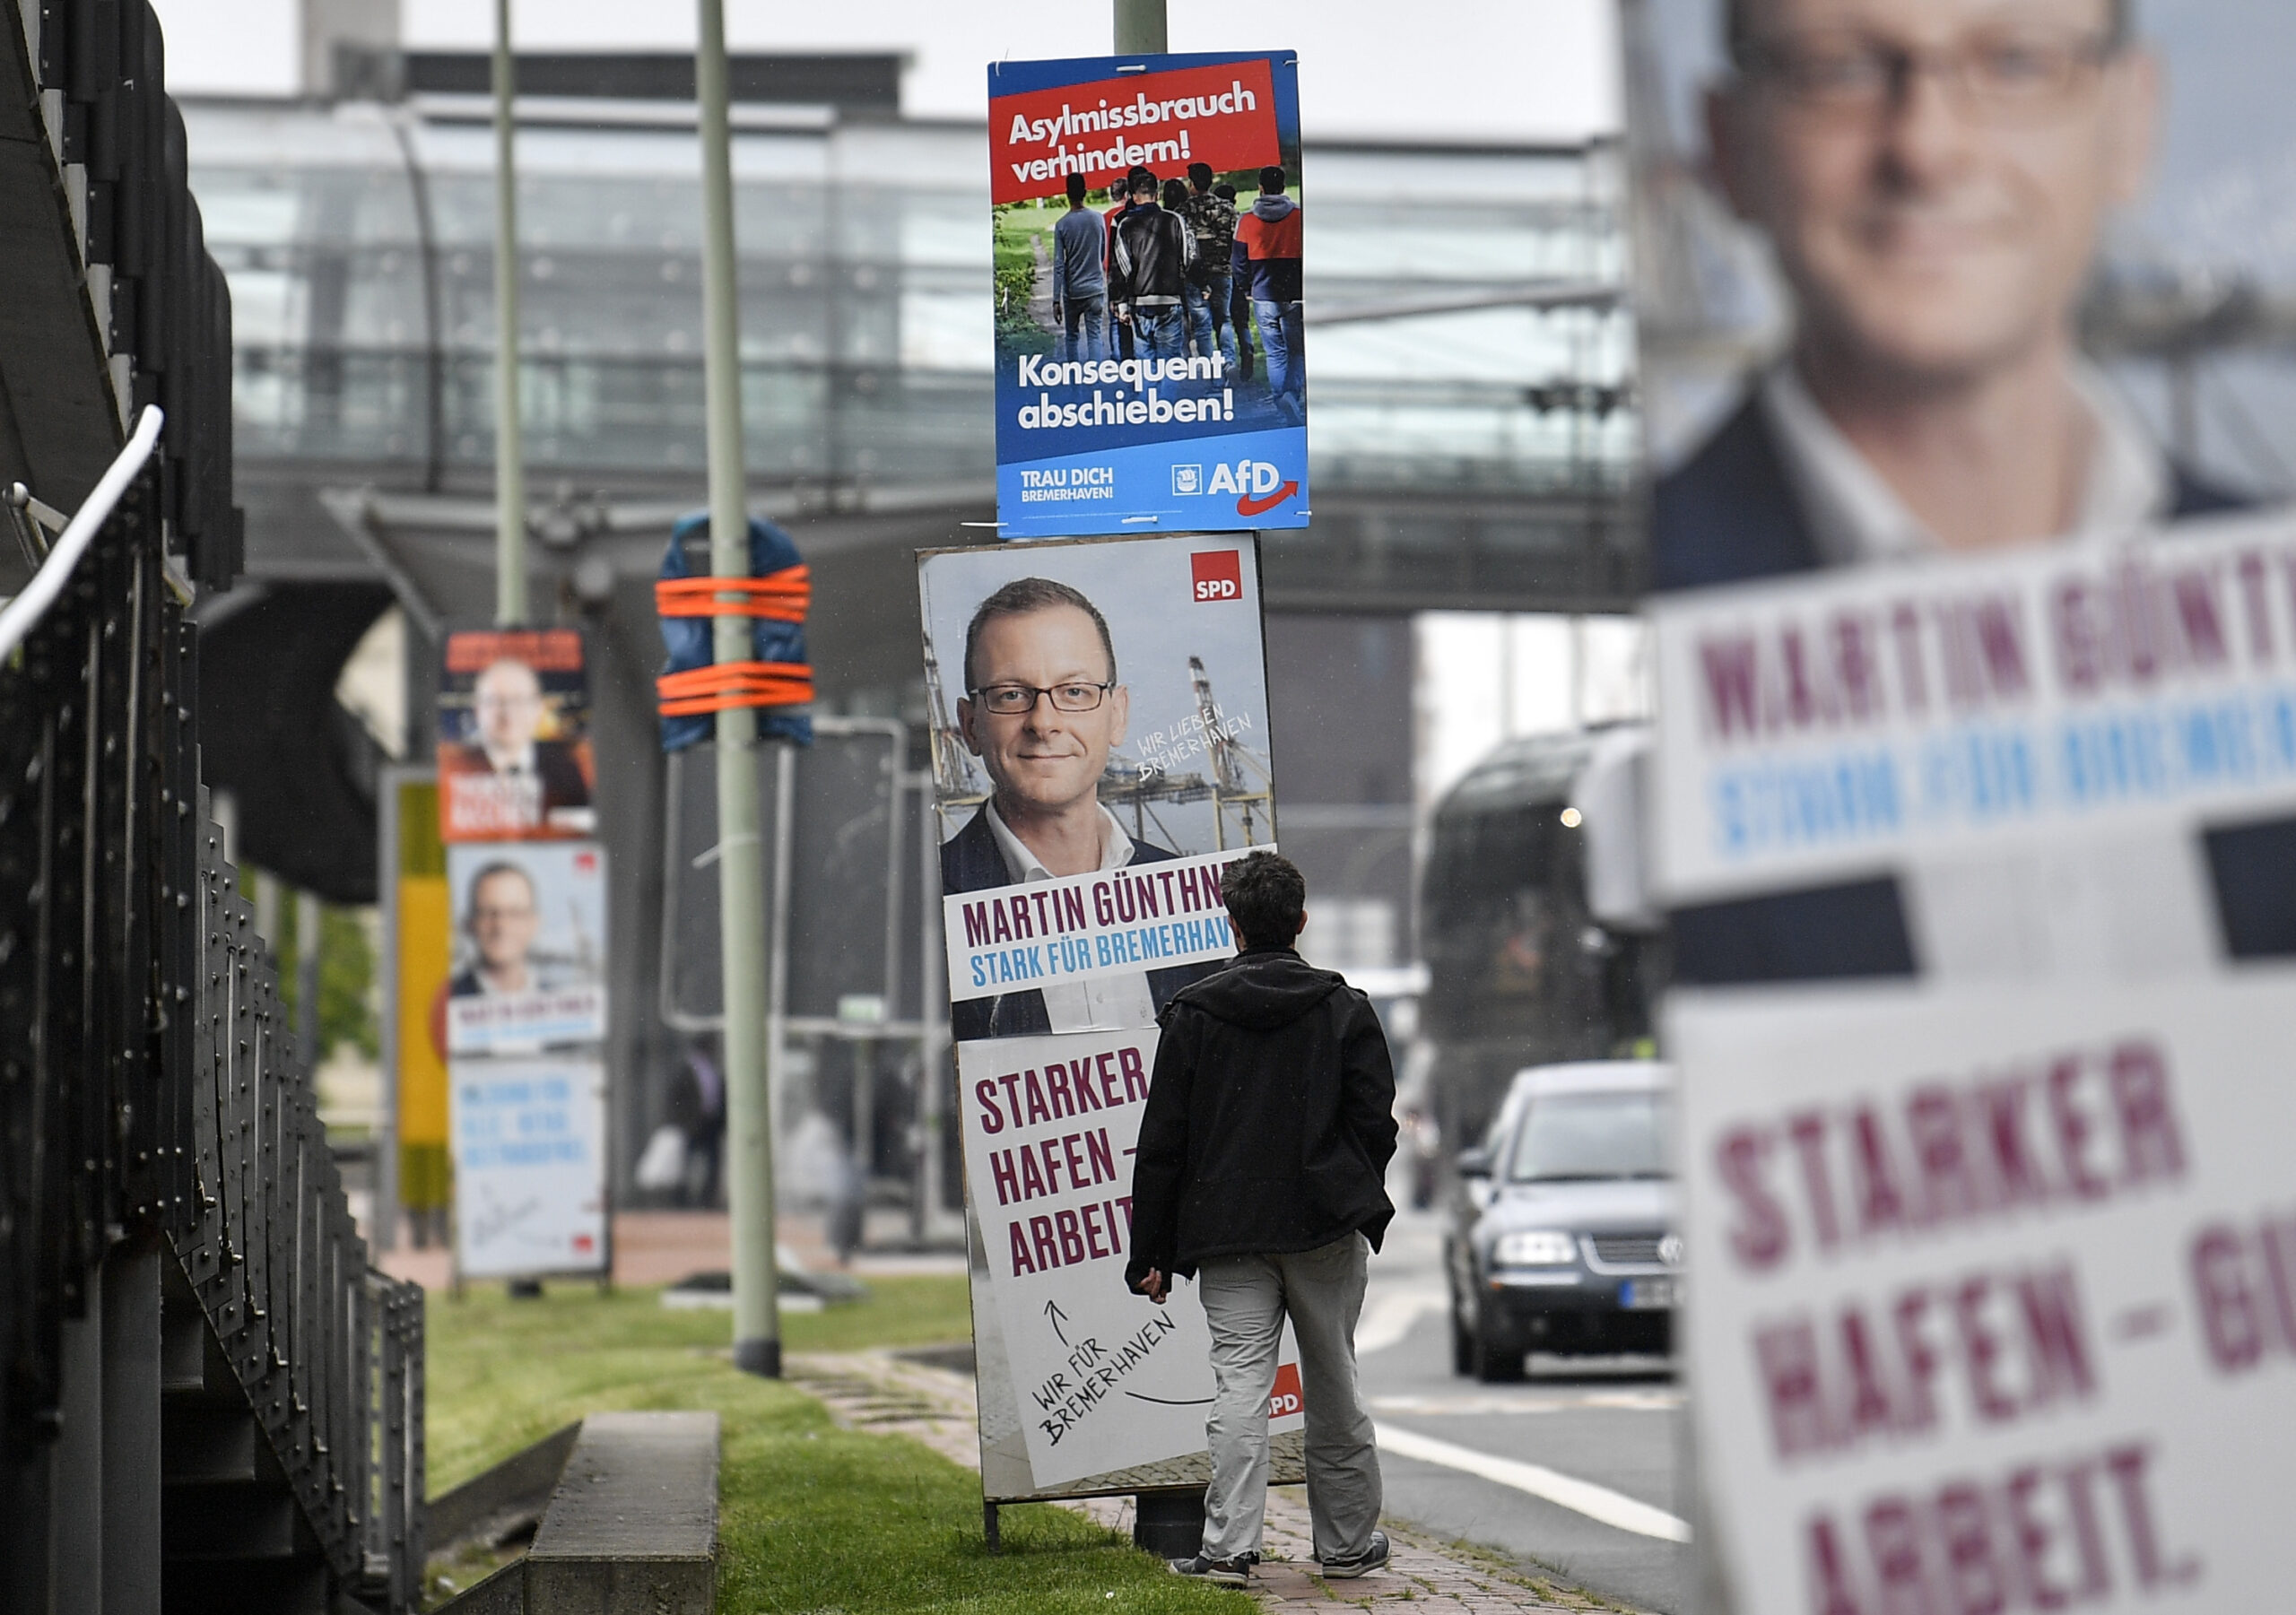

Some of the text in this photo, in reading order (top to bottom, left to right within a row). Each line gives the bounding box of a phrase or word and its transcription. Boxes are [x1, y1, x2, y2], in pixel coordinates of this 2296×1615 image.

[1009, 80, 1256, 147] Asylmissbrauch
[1012, 130, 1191, 183] verhindern!
[1018, 351, 1225, 392] Konsequent
[1018, 388, 1234, 429] abschieben!
[1021, 467, 1113, 488] TRAU DICH
[1022, 486, 1113, 502] BREMERHAVEN!
[1207, 459, 1280, 494] AfD
[1196, 579, 1235, 599] SPD
[2048, 543, 2296, 696] GÜNT
[1135, 711, 1252, 783] BREMERHAVEN
[1137, 703, 1225, 757] WIR LIEBEN
[962, 862, 1231, 949] MARTIN GÜNTHN
[970, 915, 1231, 987] STARK FÜR BREMERHAV
[975, 1046, 1149, 1134] STARKER
[989, 1127, 1117, 1206] HAFEN
[1715, 1036, 2188, 1273] STARKER
[1032, 1337, 1108, 1411] WIR FÜR
[1039, 1310, 1177, 1446] BREMERHAVEN
[1751, 1257, 2097, 1471] HAFEN
[1268, 1394, 1299, 1415] PD
